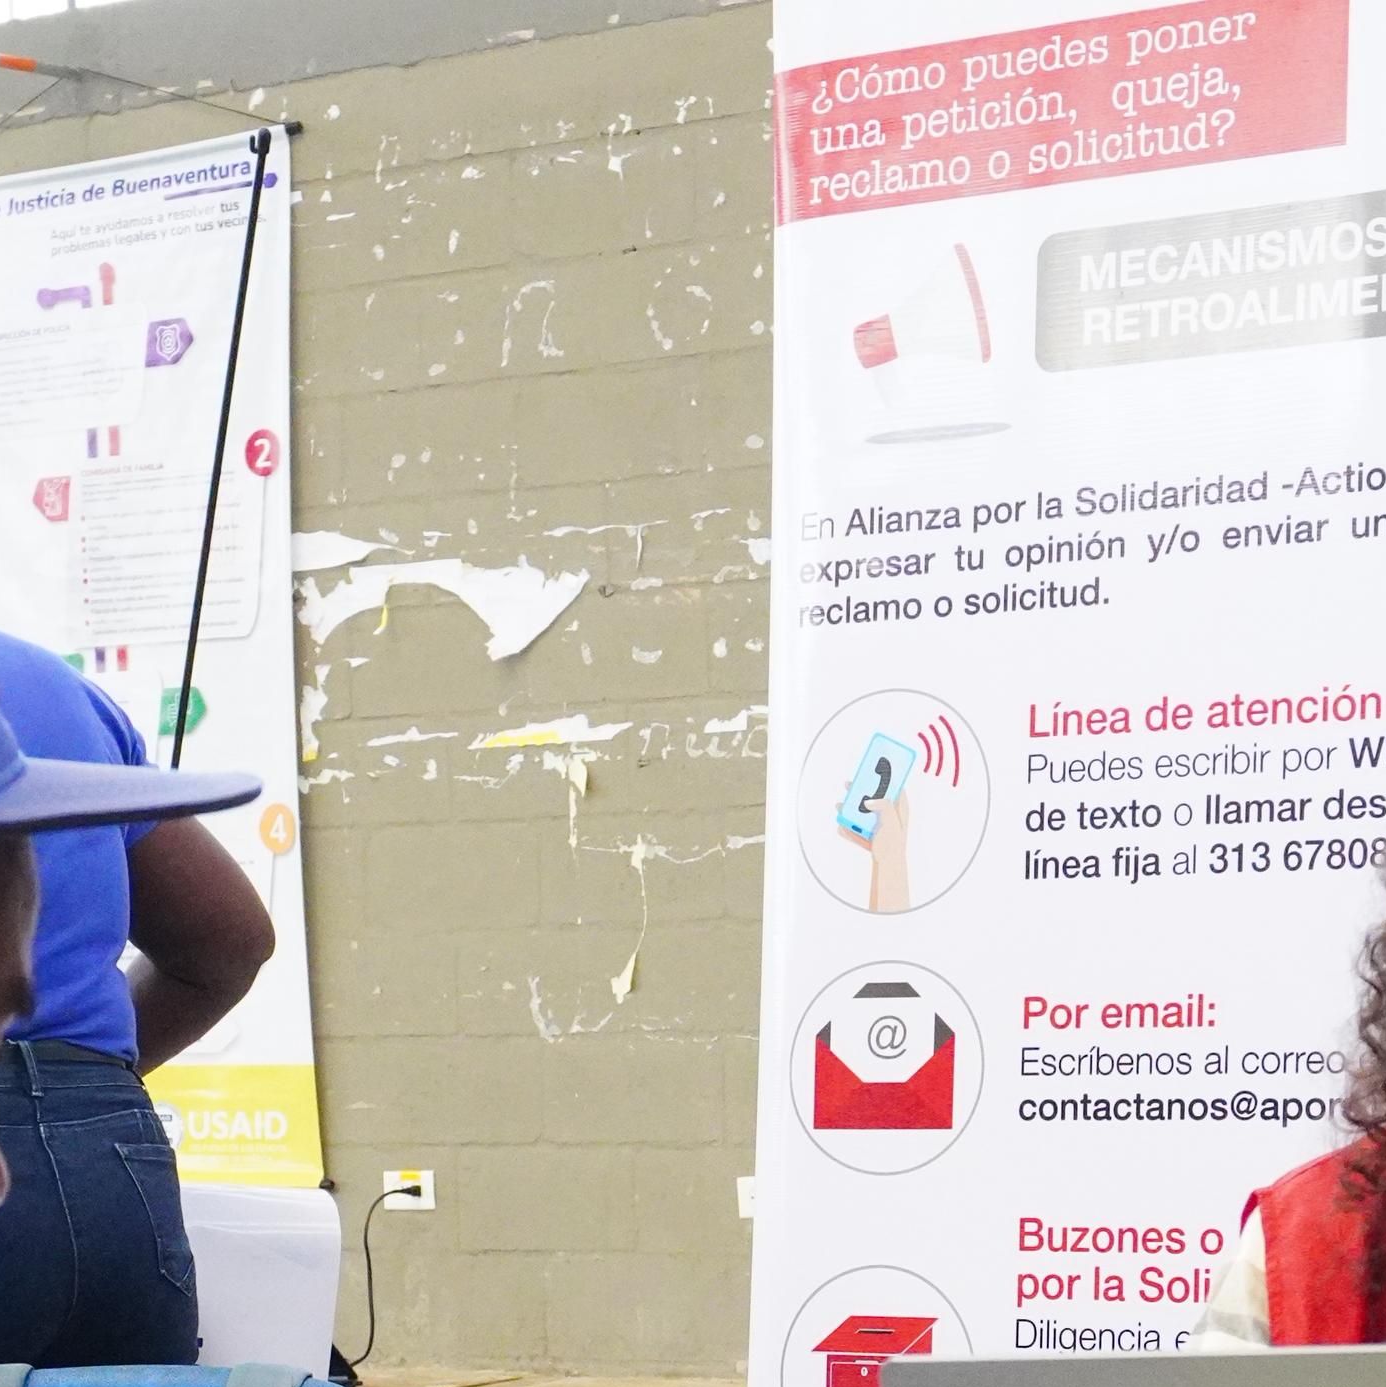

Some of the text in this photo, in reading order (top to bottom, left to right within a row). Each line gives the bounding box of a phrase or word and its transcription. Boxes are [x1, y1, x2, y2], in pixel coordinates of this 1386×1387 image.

[811, 10, 1257, 116] ¿Cómo puedes poner
[811, 62, 1243, 156] una petición, queja,
[809, 108, 1237, 205] reclamo o solicitud?
[7, 187, 75, 217] Justicia
[82, 182, 105, 202] de
[112, 160, 252, 196] Buenaventura
[220, 199, 239, 213] tus
[253, 438, 272, 468] 2
[801, 512, 835, 541] En
[845, 505, 961, 536] Alianza
[973, 499, 1026, 531] por
[1037, 492, 1063, 519] la
[1075, 471, 1268, 517] Solidaridad
[799, 550, 935, 587] expresar
[955, 545, 984, 571] tu
[1005, 531, 1125, 571] opinión
[1147, 524, 1200, 563] y/o
[1222, 514, 1329, 549] enviar
[798, 577, 1109, 628] reclamo o solicitud.
[1029, 684, 1382, 738] Línea de atención
[1027, 752, 1142, 784] Puedes
[1155, 743, 1271, 778] escribir
[1282, 746, 1337, 779] por
[269, 814, 288, 844] 4
[1025, 802, 1066, 832] de
[1077, 801, 1161, 830] texto
[1174, 804, 1193, 826] o
[1206, 795, 1311, 825] llamar
[1025, 850, 1100, 879] línea
[1112, 846, 1160, 884] fija
[1173, 845, 1197, 875] al
[1209, 841, 1271, 873] 313
[1023, 994, 1216, 1029] Por email:
[1021, 1046, 1345, 1076] Escríbenos al correo
[188, 1109, 289, 1141] USAID
[1019, 1217, 1224, 1254] Buzones o
[1017, 1273, 1081, 1307] por
[1094, 1267, 1125, 1301] la
[1015, 1319, 1160, 1352] Diligencia
